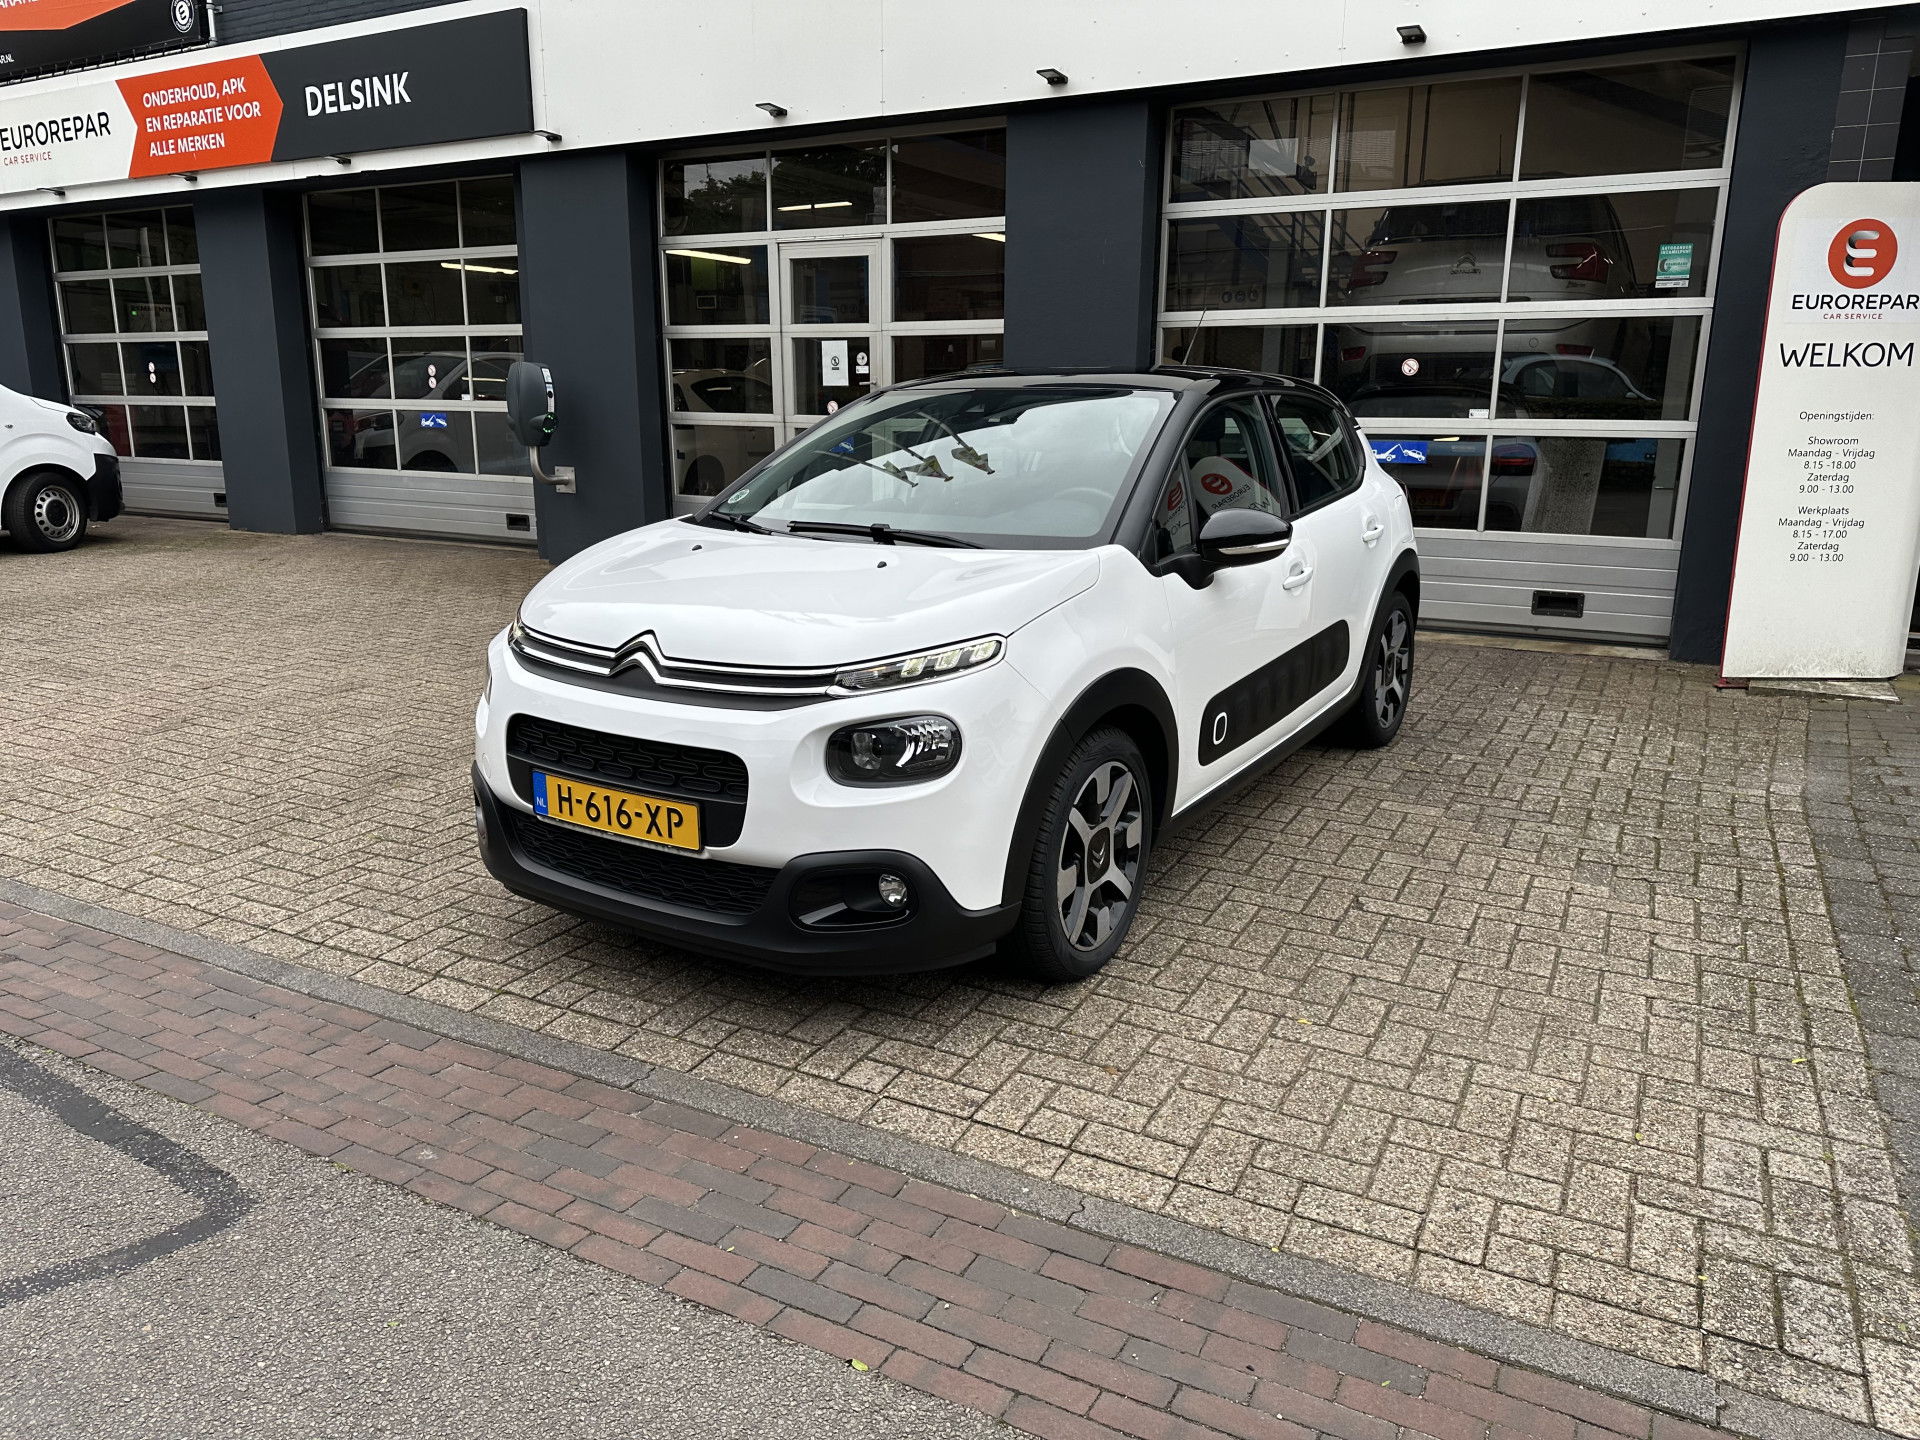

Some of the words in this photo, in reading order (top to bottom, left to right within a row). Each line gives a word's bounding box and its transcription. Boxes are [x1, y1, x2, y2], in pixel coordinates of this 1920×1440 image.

[143, 82, 220, 109] ONDERHOUD,
[222, 77, 247, 96] APK
[305, 71, 412, 117] DELSINK
[146, 117, 162, 133] EN
[163, 107, 224, 131] REPARATIE
[224, 101, 262, 121] VOOR
[0, 111, 111, 151] EUROREPAR
[149, 139, 177, 157] ALLE
[178, 133, 226, 153] MERKEN
[3, 155, 19, 166] CAR
[20, 151, 53, 165] SERVICE
[1791, 293, 1920, 310] EUROREPAR
[1779, 342, 1915, 368] WELKOM
[1799, 411, 1874, 422] Openingstijden:
[1807, 435, 1859, 446] Showroom
[1787, 448, 1832, 460] Maandag
[1842, 448, 1876, 460] Vrijdag
[1803, 460, 1824, 470] 8.15
[1806, 472, 1850, 484] Zaterdag
[1799, 484, 1819, 494] 9.00
[1829, 484, 1855, 494] 13.00
[1798, 505, 1850, 517] Werkplaats
[1778, 517, 1822, 529] Maandag
[1832, 517, 1865, 529] Vrijdag
[1792, 529, 1812, 539] 8.15
[1822, 529, 1848, 539] 17.00
[1797, 541, 1840, 553] Zaterdag
[1789, 553, 1809, 562] 9.00
[1819, 553, 1844, 562] 13.00
[536, 796, 547, 808] NL
[557, 783, 684, 839] H-616-XP
